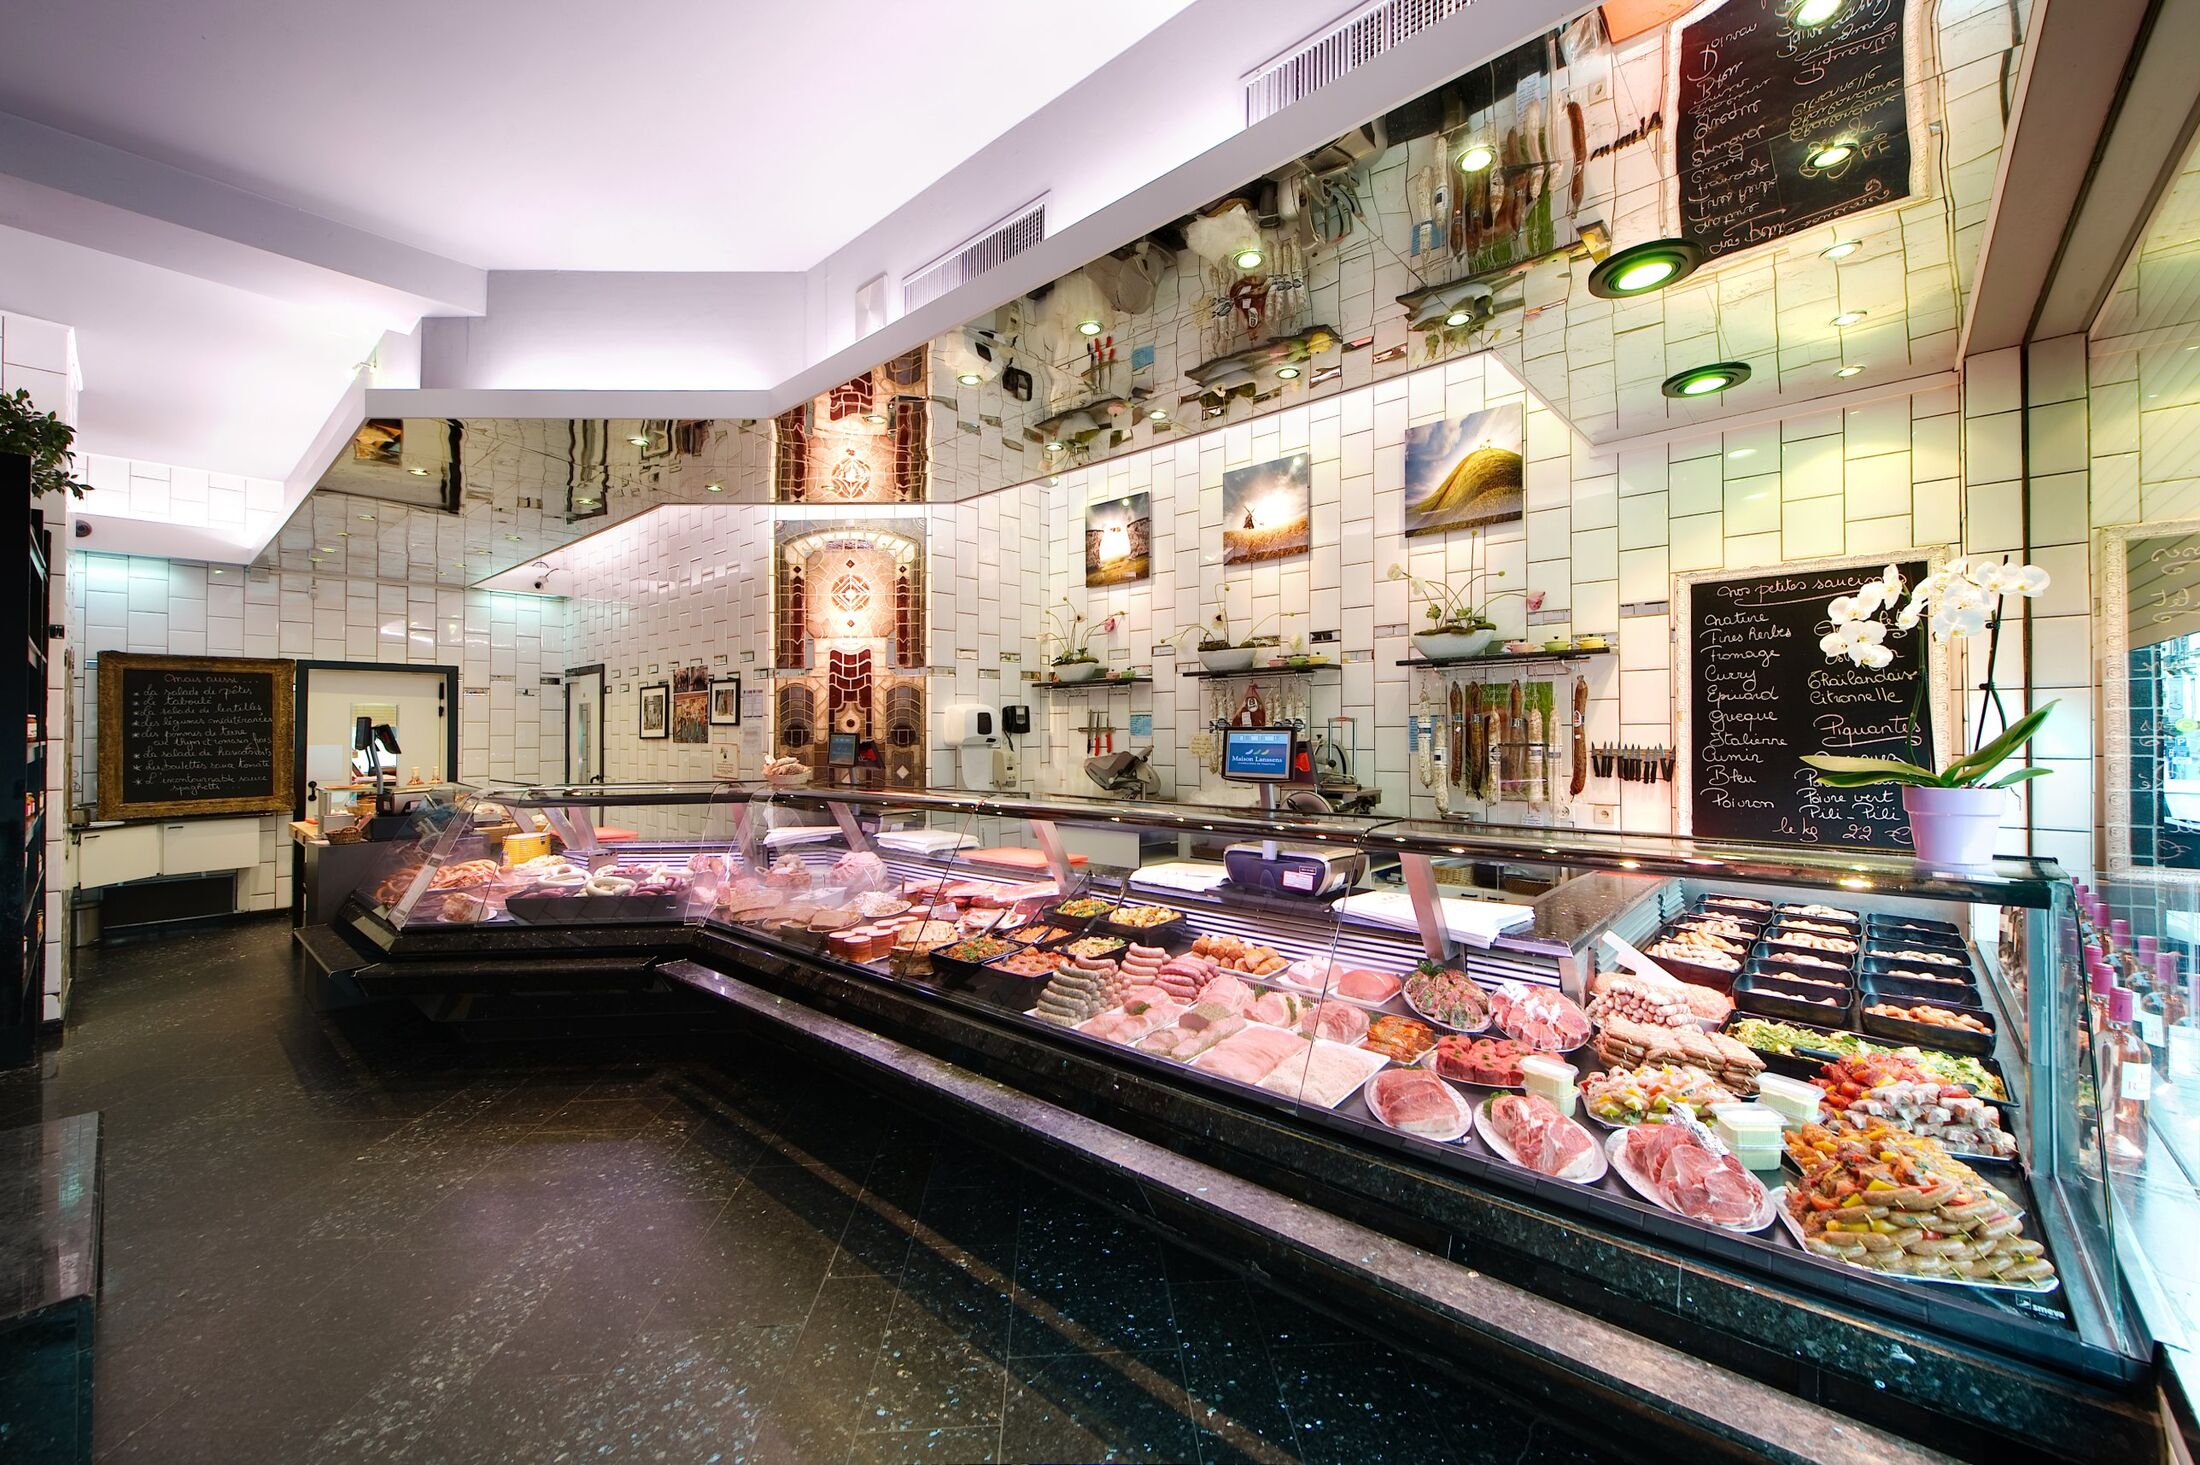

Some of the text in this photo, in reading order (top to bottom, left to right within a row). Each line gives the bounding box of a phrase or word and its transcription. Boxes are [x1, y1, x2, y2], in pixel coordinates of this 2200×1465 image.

[1700, 628, 1743, 644] Fines
[1700, 645, 1780, 667] Fromage
[1705, 664, 1756, 691] Curry
[163, 687, 199, 696] salade
[203, 686, 217, 695] de
[219, 685, 252, 700] pâtes
[1810, 687, 1903, 705] Citronnelle
[161, 706, 195, 714] salade
[216, 702, 262, 713] lentilles
[165, 731, 202, 743] pommes
[204, 728, 217, 737] de
[220, 726, 247, 736] terre
[1813, 713, 1921, 747] Piquantes
[160, 749, 197, 757] salade
[1706, 764, 1757, 786] Bleu
[1700, 787, 1775, 809] Poivron
[1797, 787, 1894, 803] Poivre vert
[1772, 817, 1797, 834] le
[1800, 818, 1818, 842] kg
[1842, 824, 1872, 841] 22
